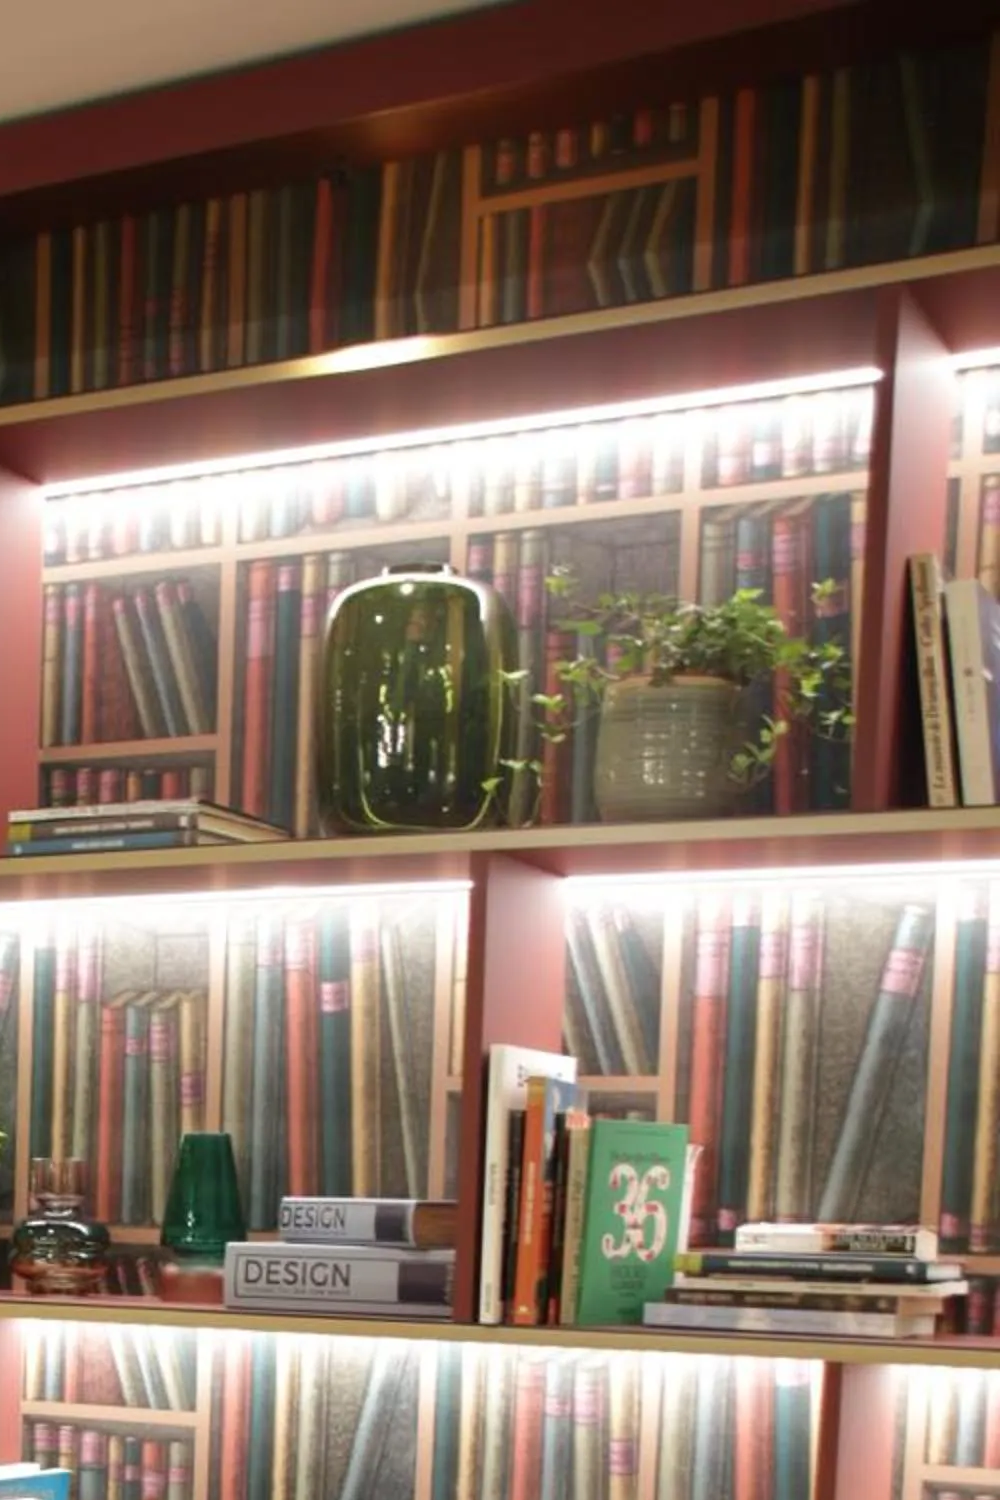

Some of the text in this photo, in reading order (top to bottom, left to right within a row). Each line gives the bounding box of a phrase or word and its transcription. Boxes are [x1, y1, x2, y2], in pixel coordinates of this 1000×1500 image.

[280, 1205, 346, 1229] DESIGN
[602, 1163, 671, 1263] 36
[244, 1259, 351, 1287] DESIGN
